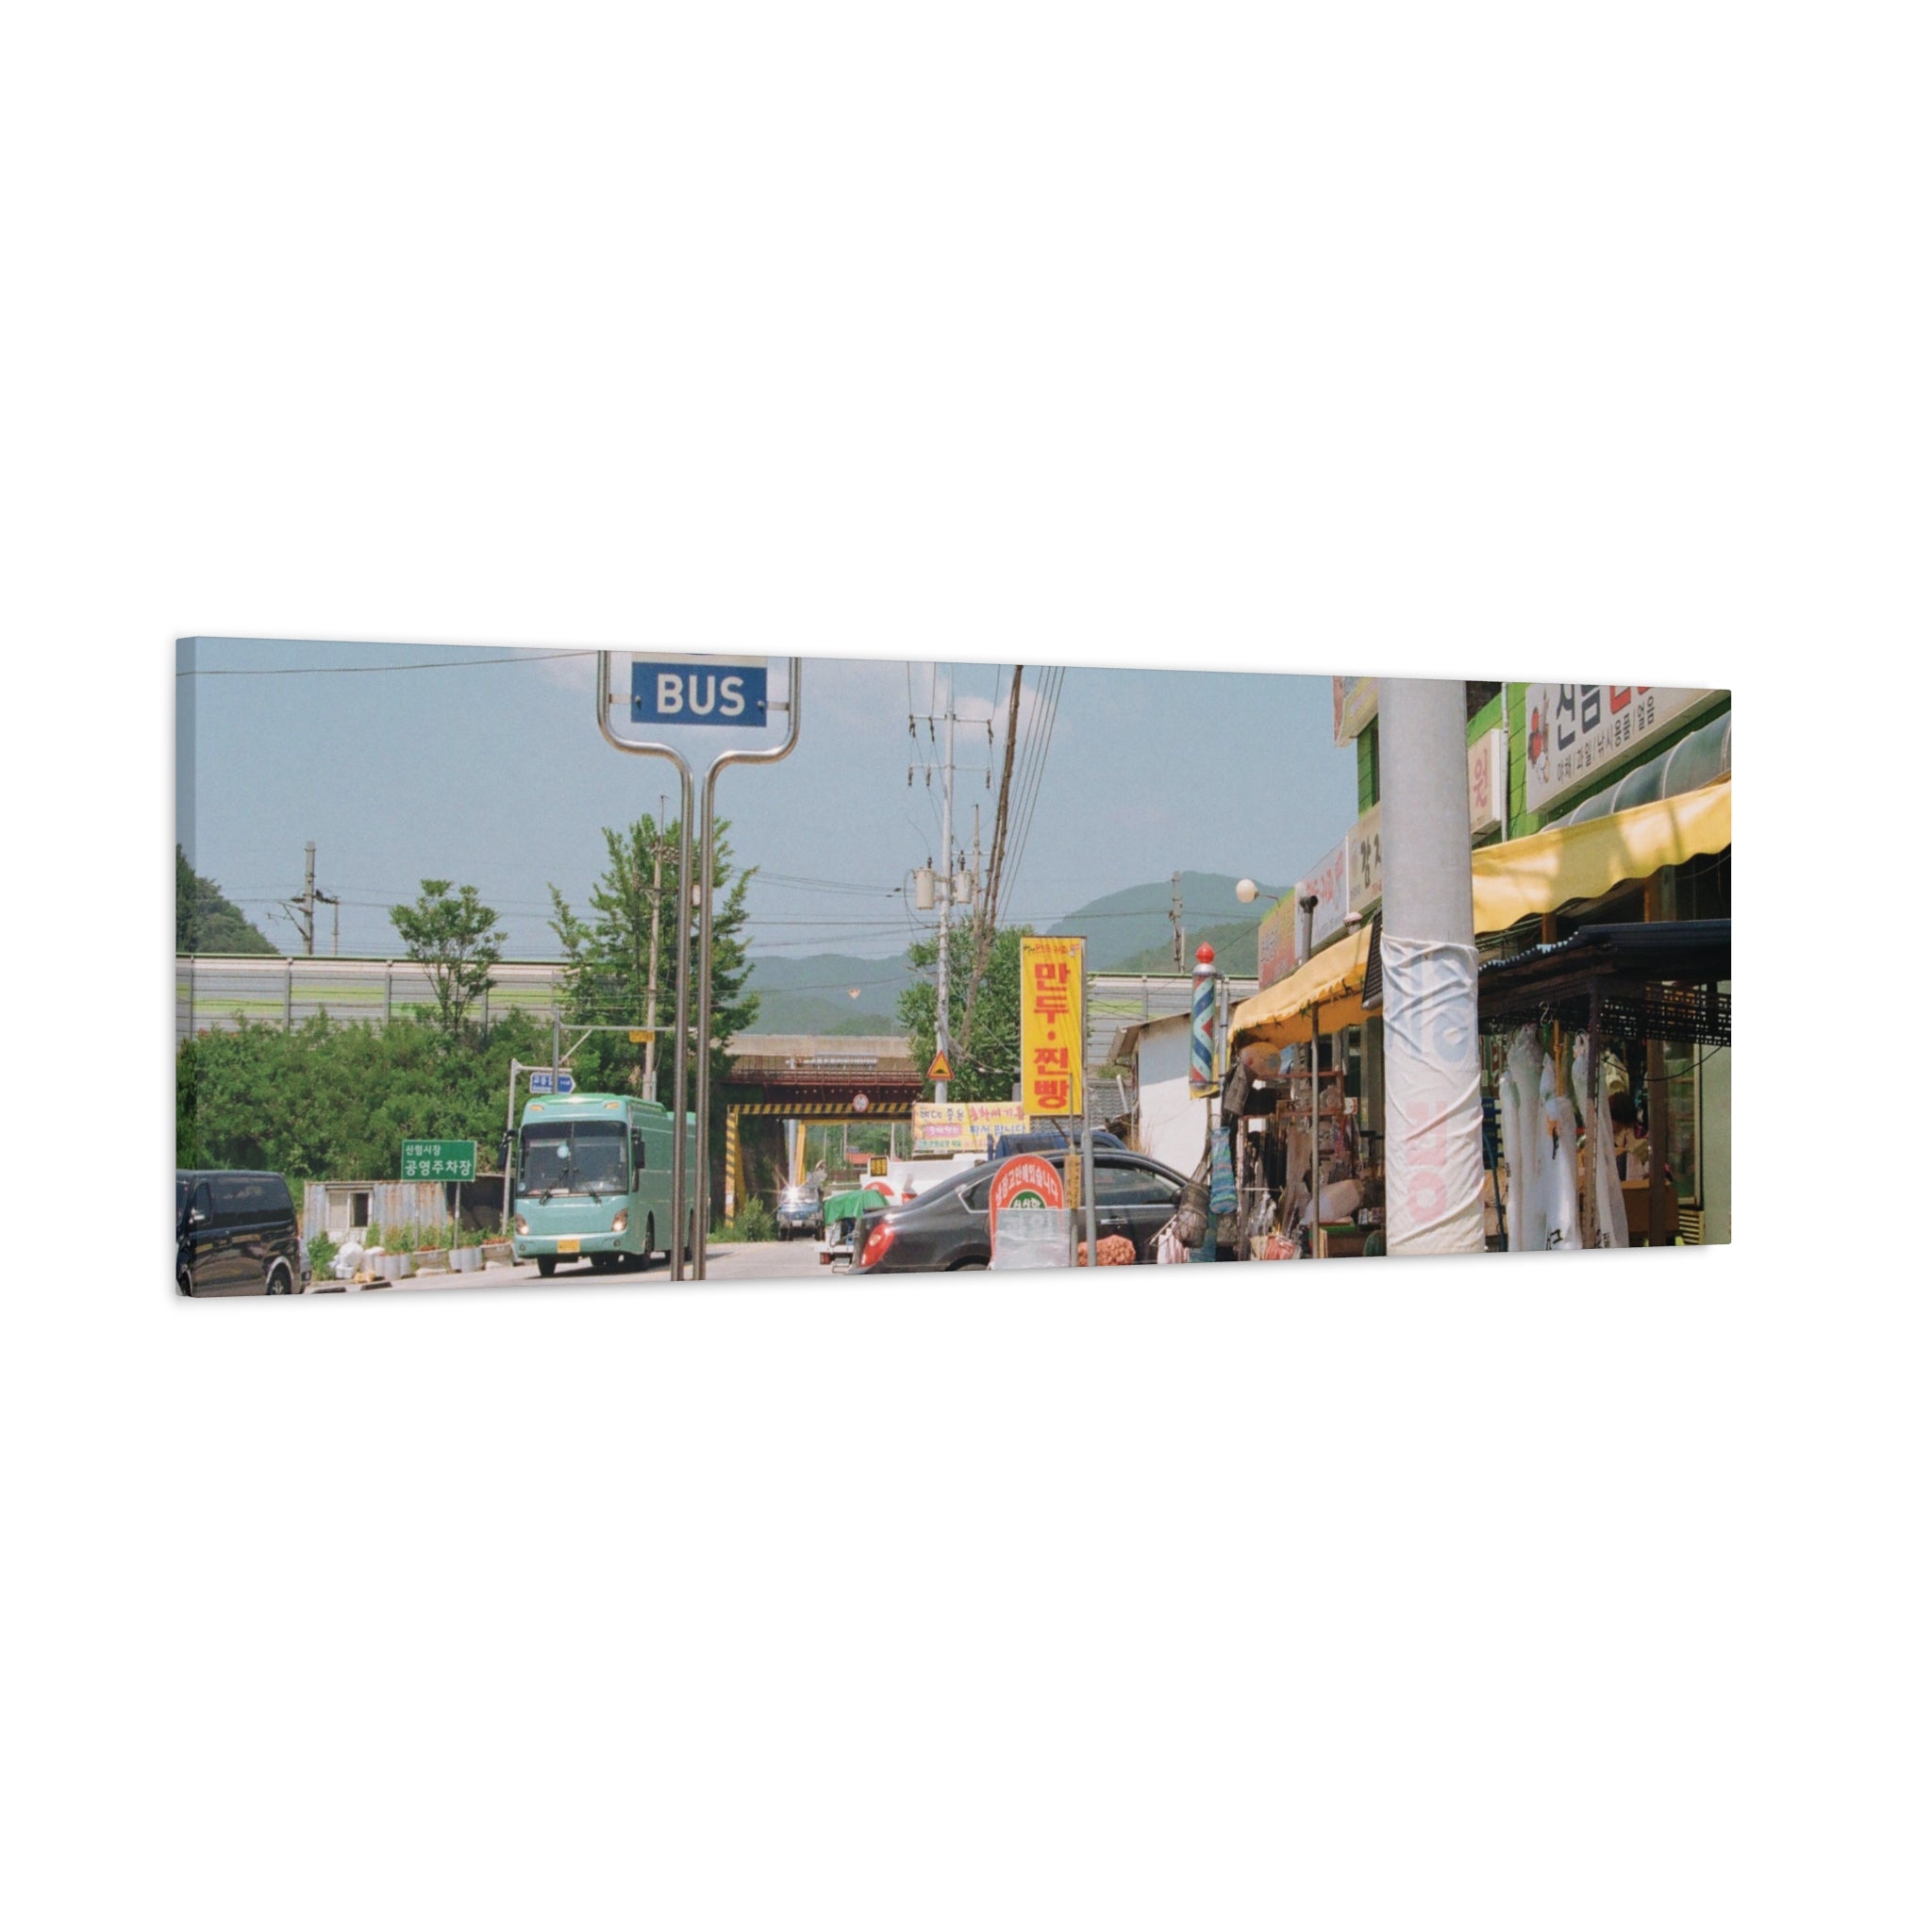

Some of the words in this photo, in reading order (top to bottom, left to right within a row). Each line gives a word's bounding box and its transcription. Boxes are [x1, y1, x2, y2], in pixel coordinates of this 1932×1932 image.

[657, 674, 746, 717] BUS
[1637, 695, 1655, 731] 얼음
[946, 1107, 965, 1122] 좋은
[405, 1159, 472, 1176] 공영주차장
